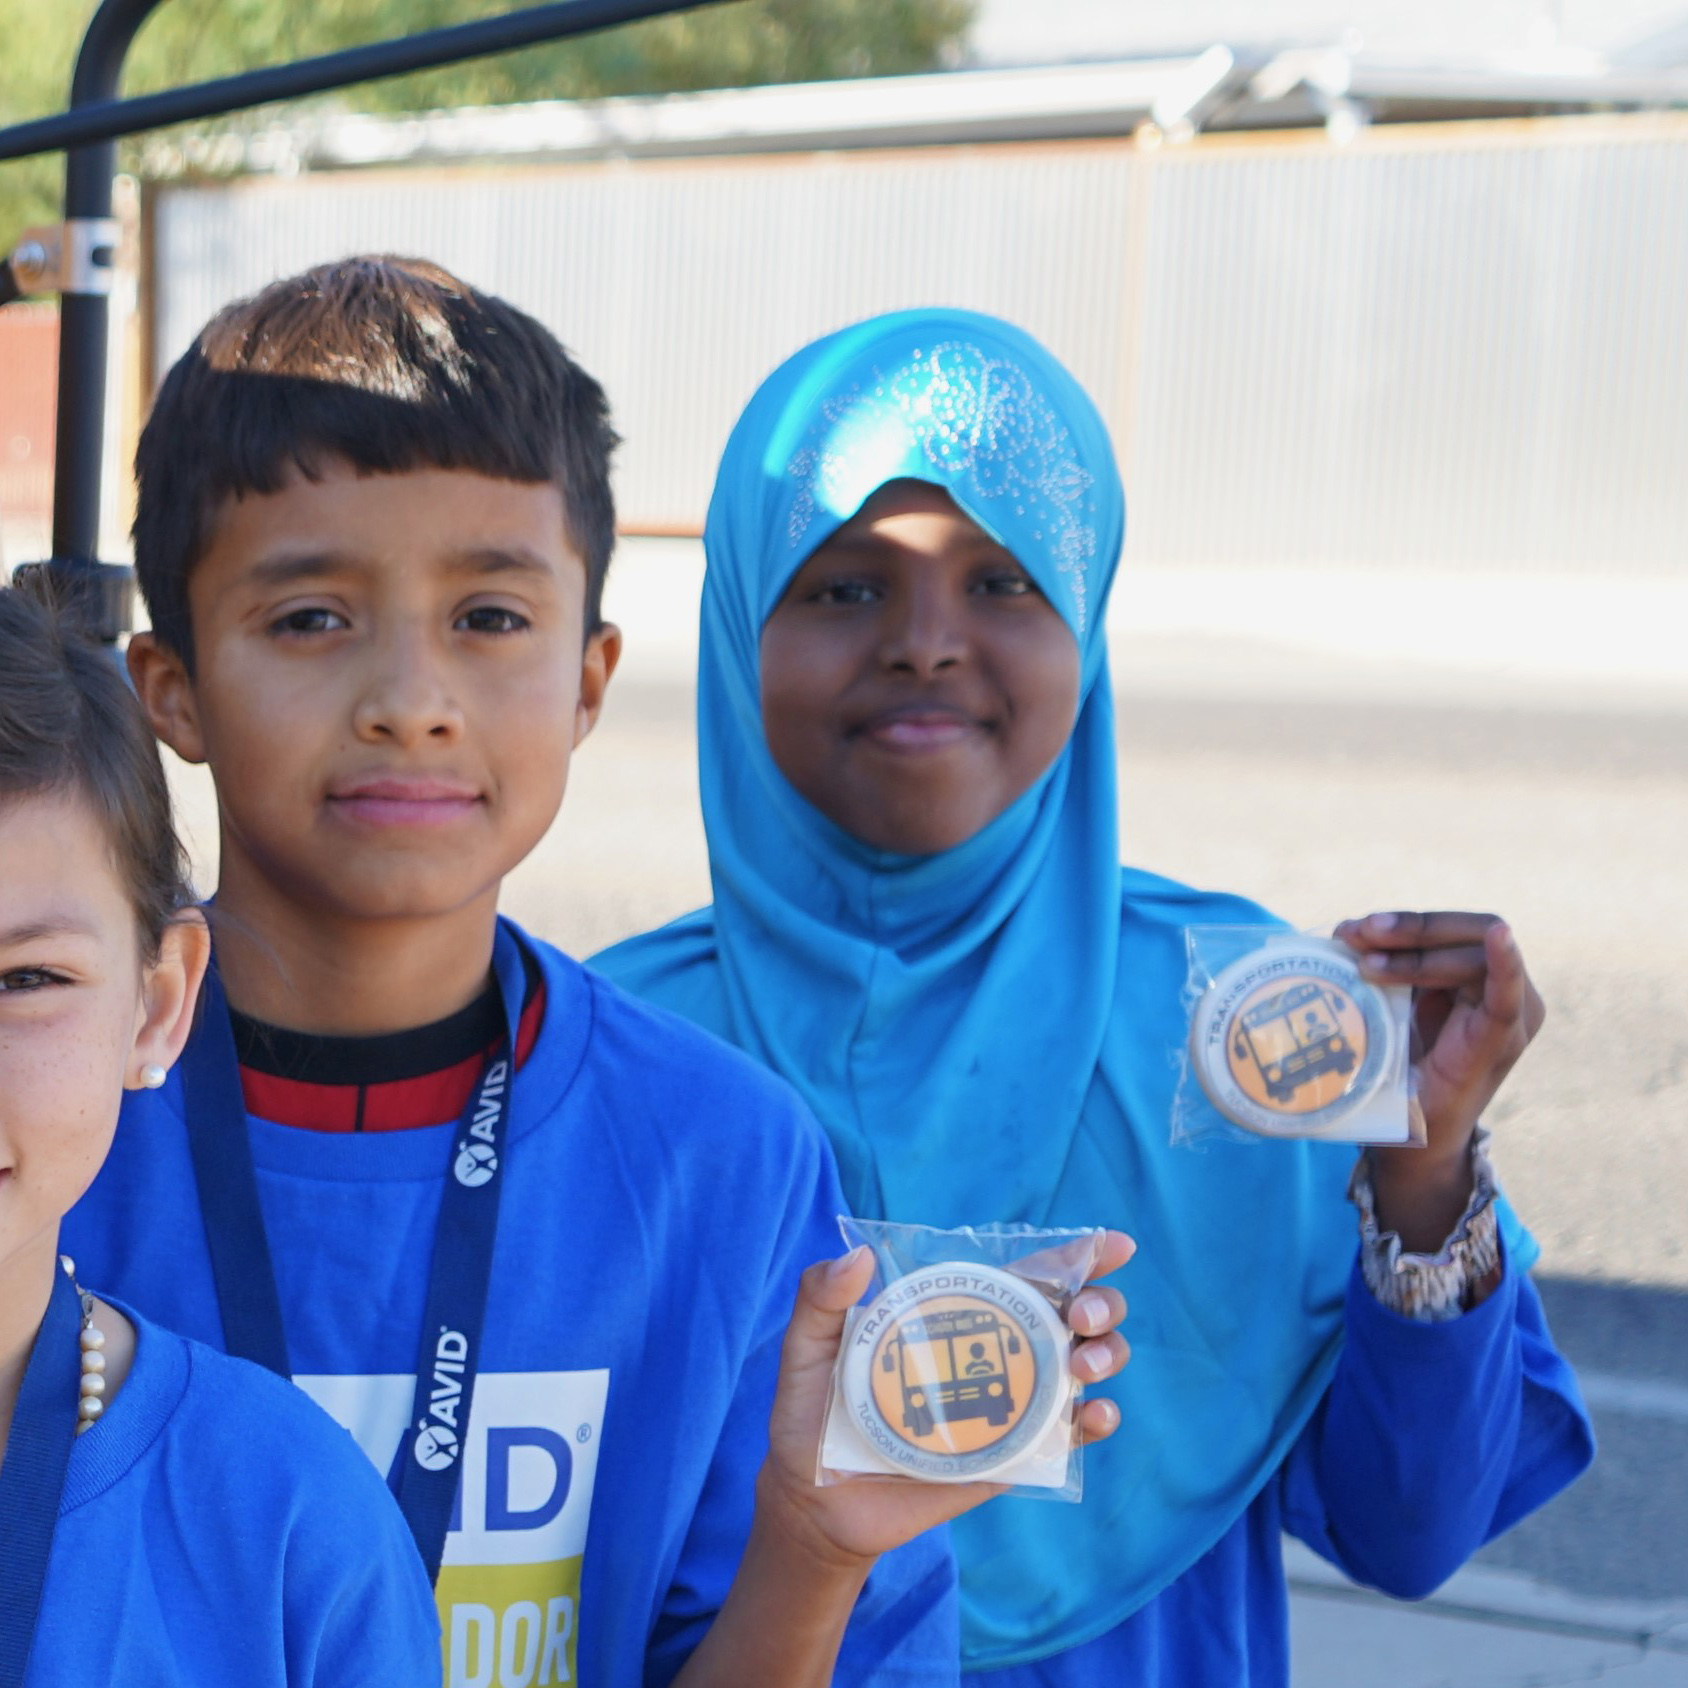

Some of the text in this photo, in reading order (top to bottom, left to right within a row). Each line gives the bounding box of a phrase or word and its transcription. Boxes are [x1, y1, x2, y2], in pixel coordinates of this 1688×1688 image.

[470, 1059, 508, 1143] AVID
[856, 1275, 1042, 1347] TRANSPORTATION
[429, 1330, 469, 1429] AVID
[856, 1400, 897, 1455] TUCSON
